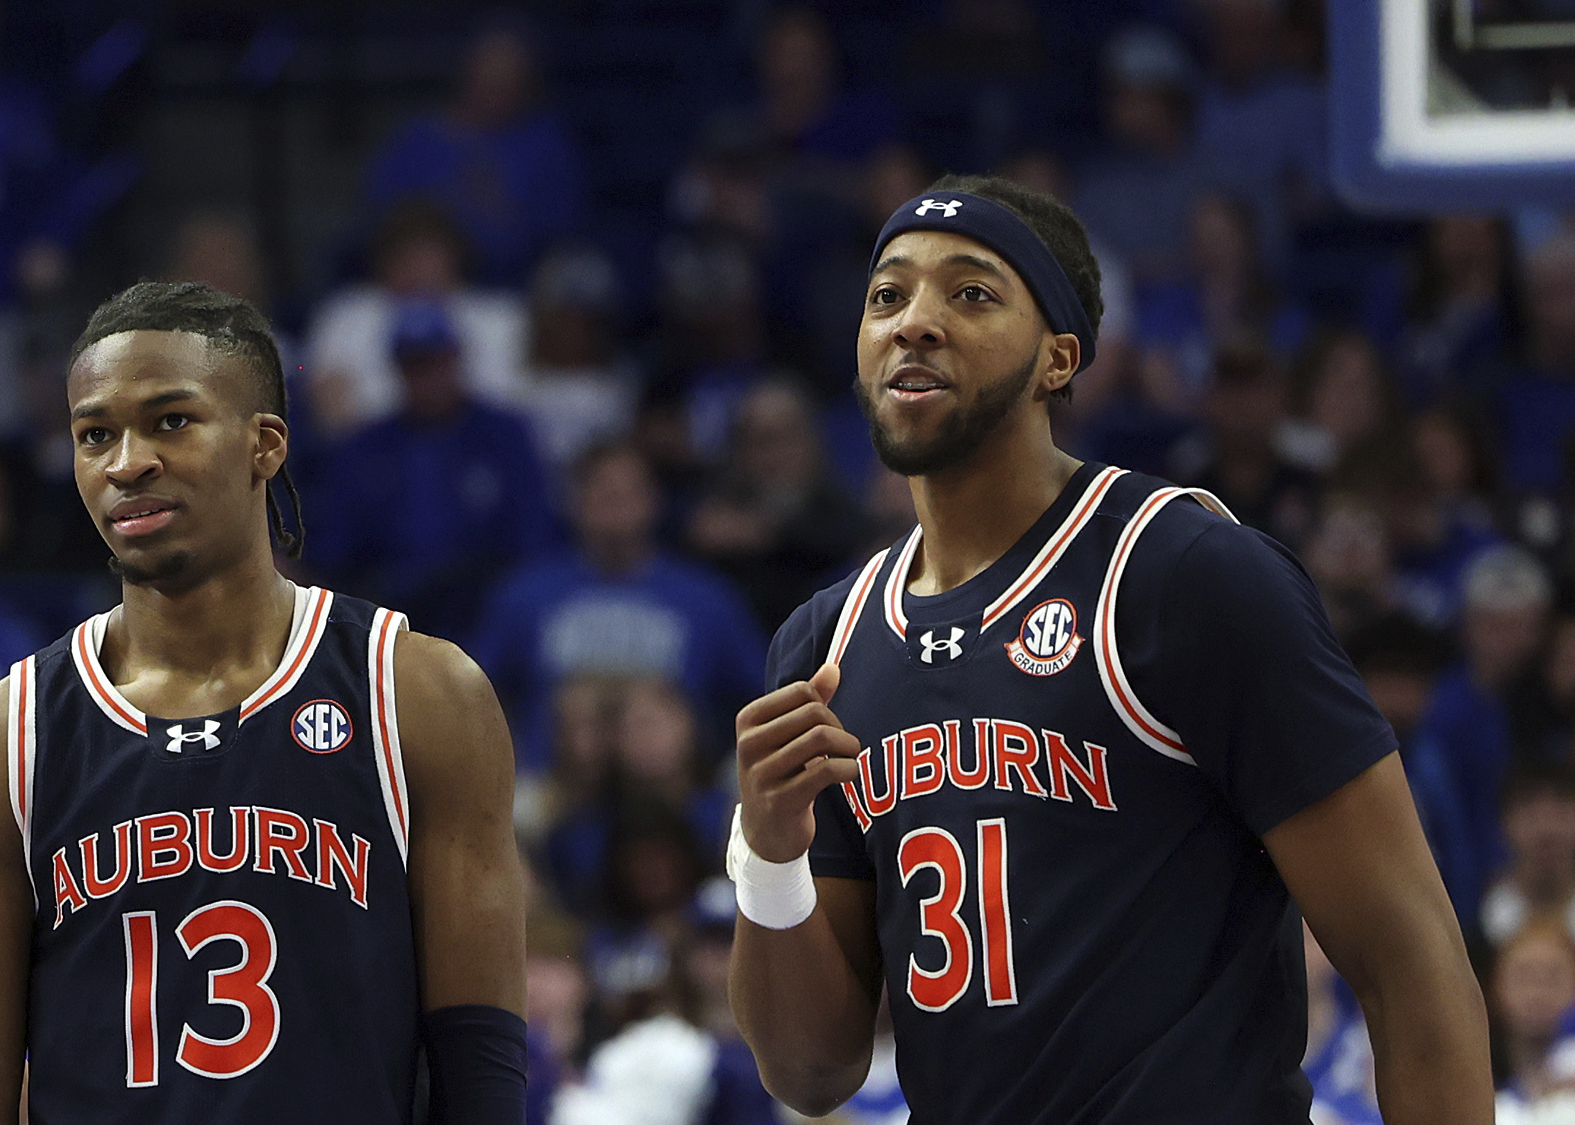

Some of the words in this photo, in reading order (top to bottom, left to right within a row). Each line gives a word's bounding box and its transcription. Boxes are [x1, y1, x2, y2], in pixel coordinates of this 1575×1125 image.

[1014, 651, 1073, 675] GRADUATE
[1025, 603, 1073, 656] SEC
[296, 704, 347, 750] SEC
[52, 805, 371, 930] AUBURN
[897, 817, 1019, 1013] 31
[122, 900, 281, 1088] 13
